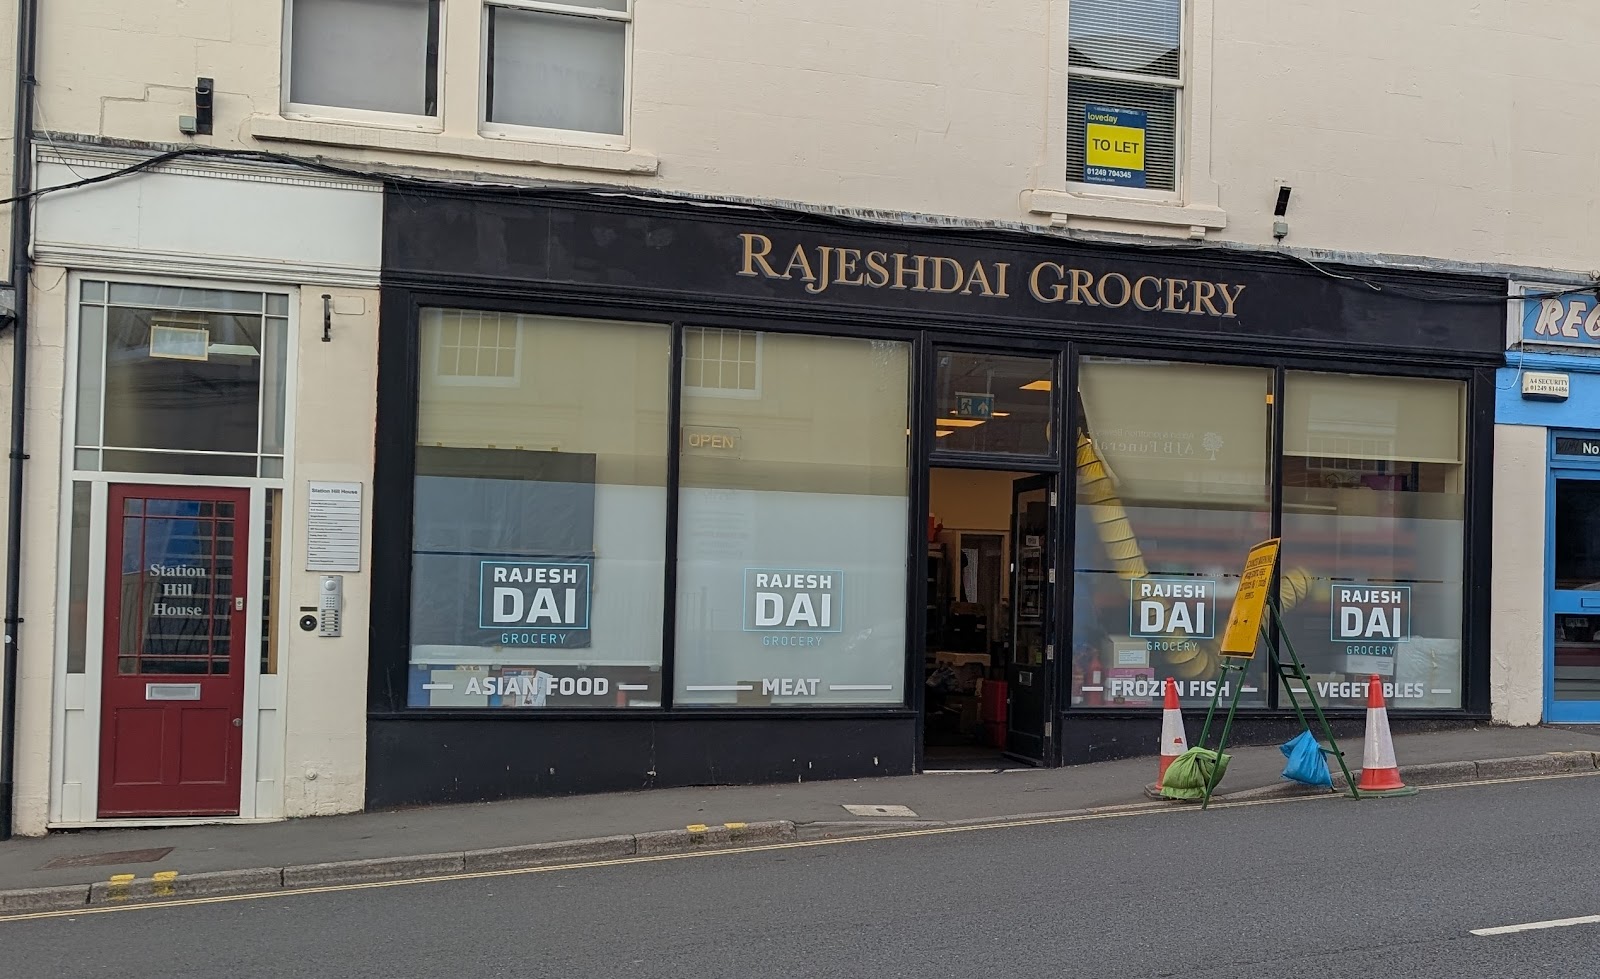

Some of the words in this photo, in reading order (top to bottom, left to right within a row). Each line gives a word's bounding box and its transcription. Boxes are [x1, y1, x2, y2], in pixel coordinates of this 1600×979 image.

[1087, 112, 1118, 124] loveday
[1092, 138, 1111, 151] TO
[1114, 140, 1140, 154] LET
[1086, 168, 1107, 176] 01249
[1108, 170, 1132, 179] 704345
[736, 232, 1011, 295] RAJESHDAI
[1029, 260, 1246, 318] GROCERY
[1538, 378, 1568, 386] SECURITY
[688, 433, 734, 449] OPEN
[1582, 442, 1599, 455] No
[149, 563, 206, 577] Station
[493, 567, 577, 584] RAJESH
[756, 573, 832, 589] RAJESH
[163, 583, 193, 596] Hill
[1141, 583, 1206, 598] RAJESH
[1341, 589, 1401, 604] RAJESH
[153, 602, 202, 616] House
[493, 586, 576, 624] DAI
[755, 592, 831, 627] DAI
[1140, 600, 1205, 634] DAI
[1340, 606, 1401, 638] DAI
[501, 633, 567, 644] GROCERY
[763, 635, 823, 646] GROCERY
[1146, 641, 1198, 652] GROCERY
[1346, 645, 1395, 655] GROCERY
[465, 677, 538, 696] ASIAN
[546, 677, 609, 696] FOOD
[762, 678, 821, 696] MEAT
[1189, 680, 1230, 697] FISH
[1317, 681, 1424, 698] VEGETBLES
